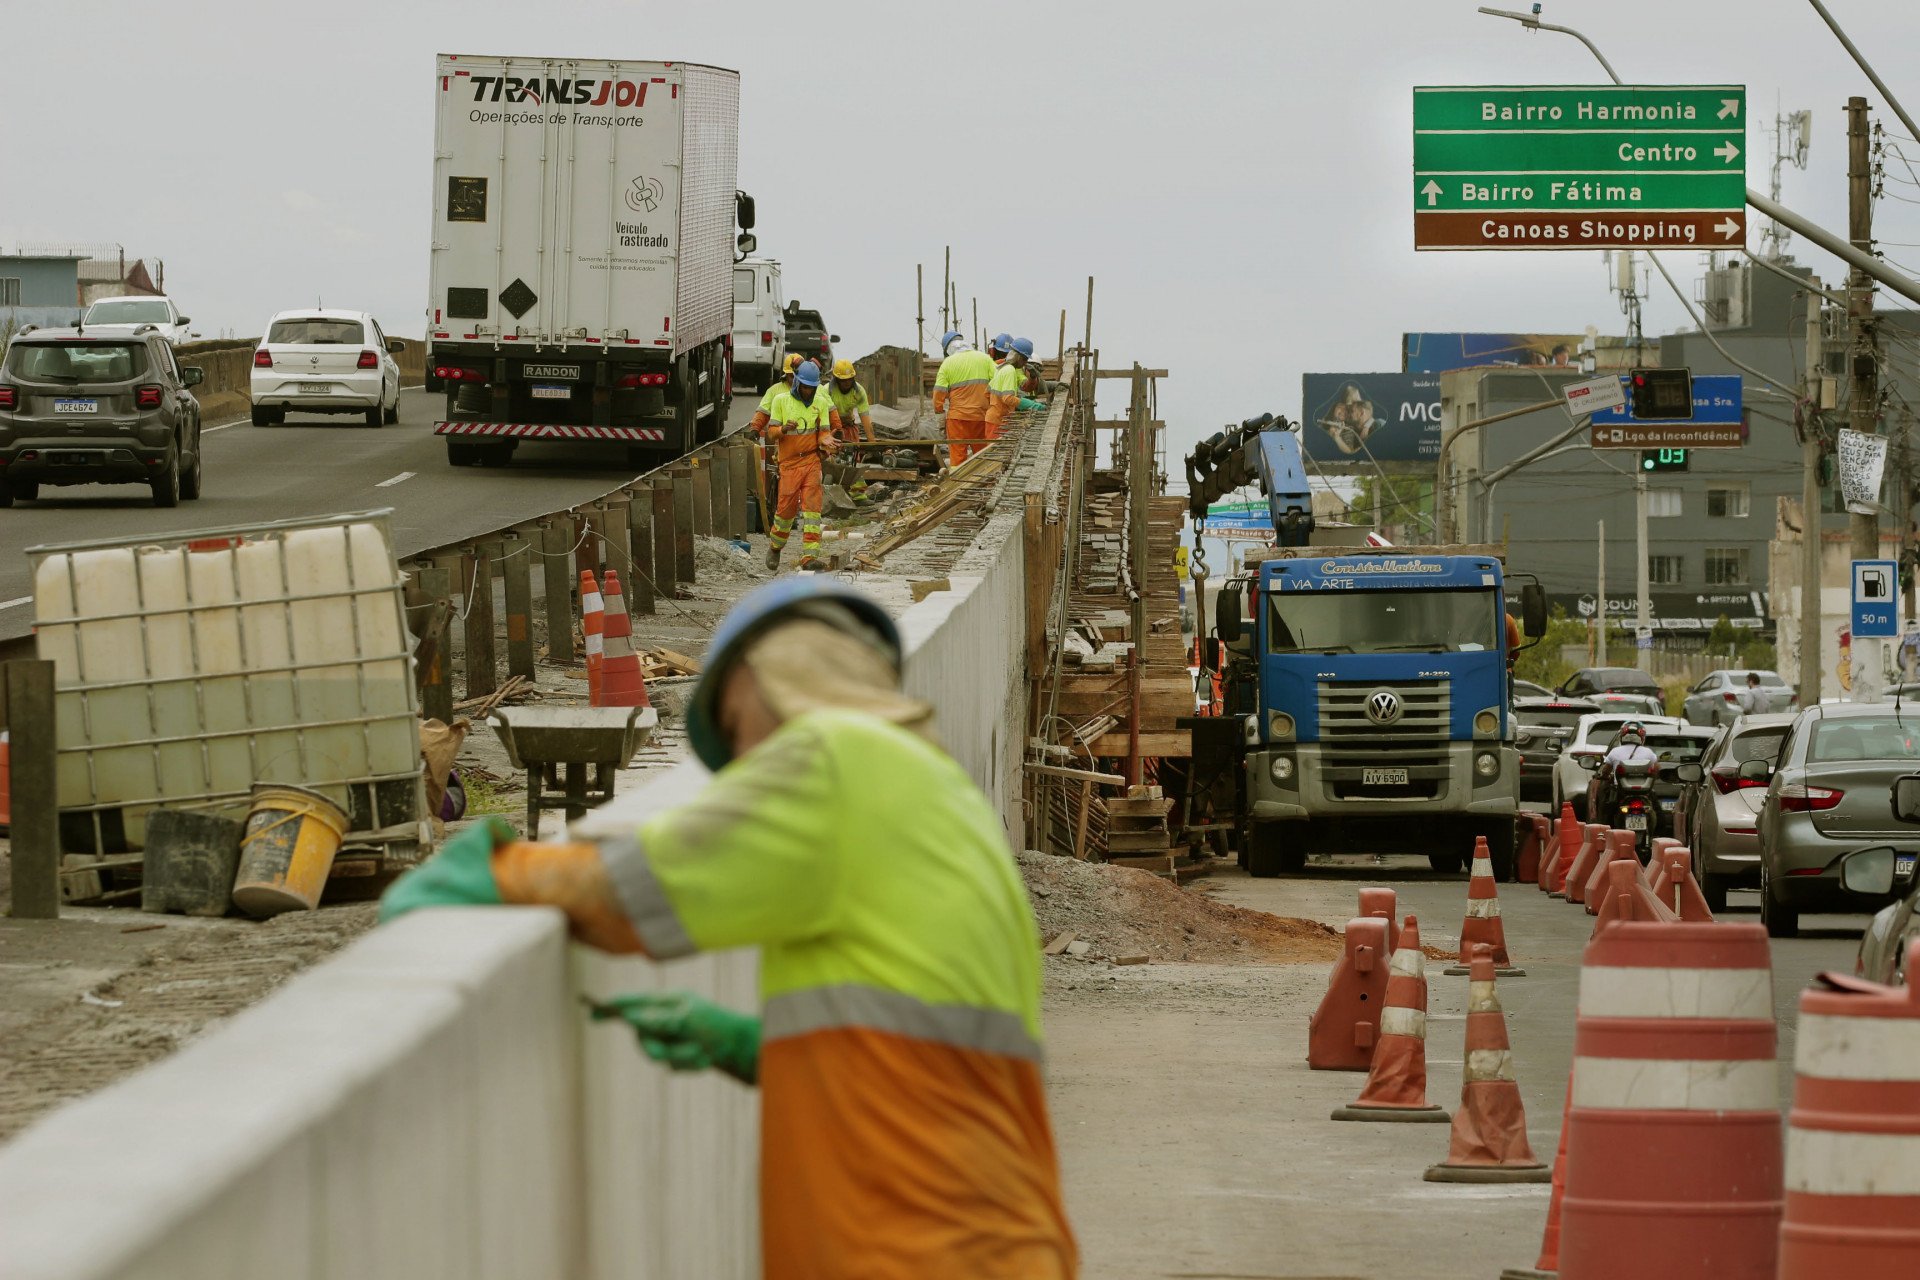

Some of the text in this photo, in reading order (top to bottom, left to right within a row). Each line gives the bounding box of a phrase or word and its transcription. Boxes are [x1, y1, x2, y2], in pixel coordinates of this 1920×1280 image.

[470, 77, 648, 107] TRANSJOI
[1481, 101, 1697, 121] Bairro Harmonia
[469, 109, 644, 129] Operações de Transporte
[1618, 142, 1697, 162] Centro
[1462, 181, 1643, 201] Bairro Fátima
[1481, 220, 1697, 243] Canoas Shopping
[620, 234, 669, 248] rastreado
[526, 367, 578, 377] RANDON
[1714, 397, 1734, 406] Sra.
[1647, 431, 1661, 441] da
[1662, 431, 1740, 441] Inconfidência
[1321, 560, 1442, 574] Constellation
[1291, 579, 1313, 590] VIA
[1320, 578, 1354, 590] ARTE
[1861, 614, 1888, 624] 50 m
